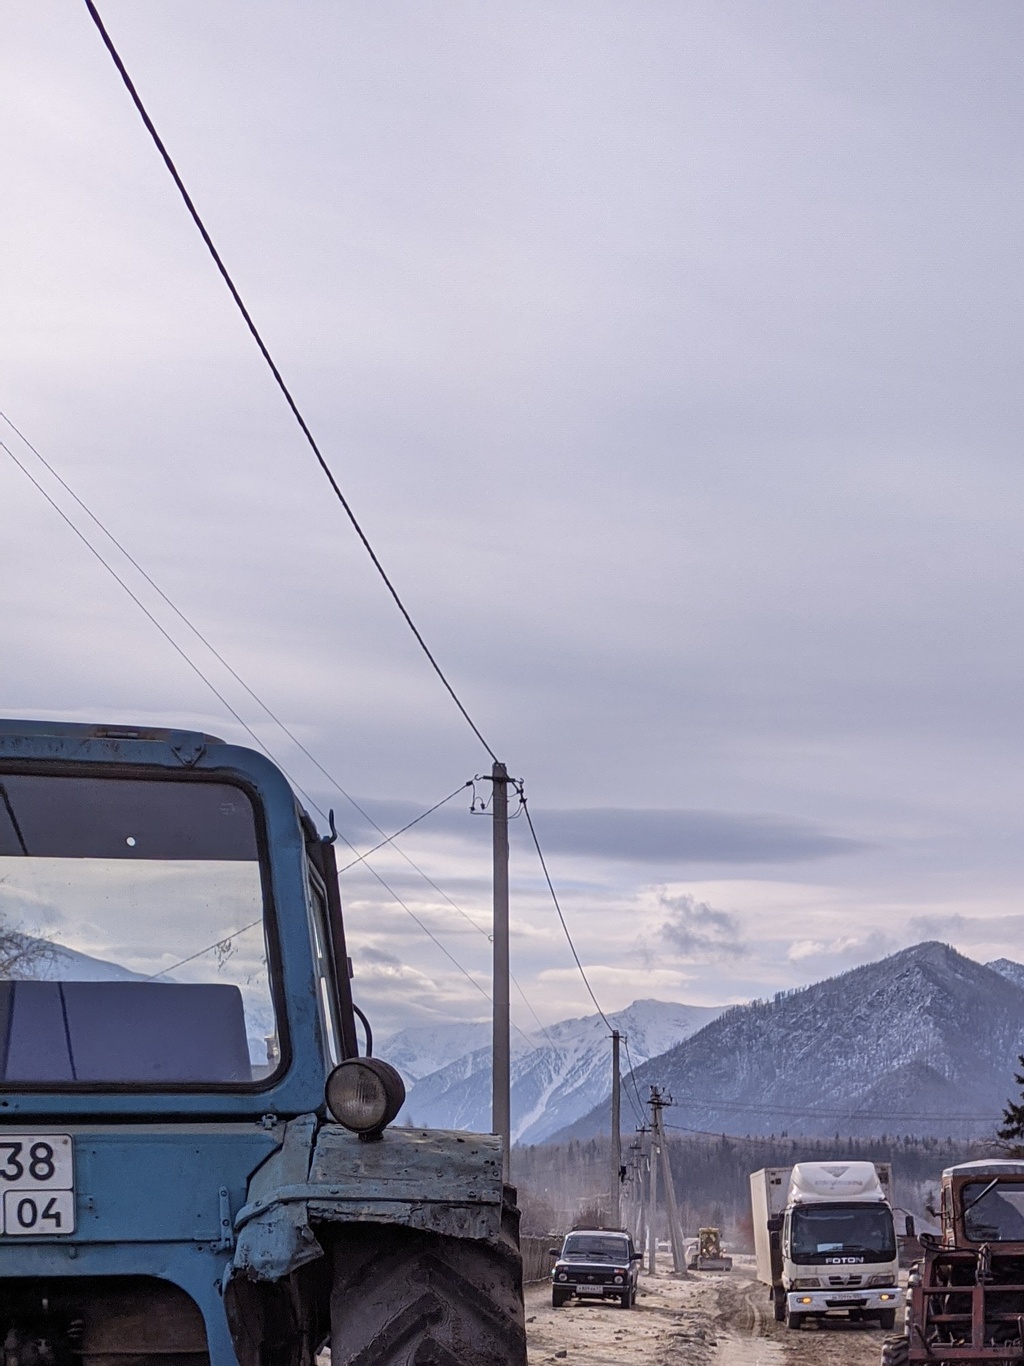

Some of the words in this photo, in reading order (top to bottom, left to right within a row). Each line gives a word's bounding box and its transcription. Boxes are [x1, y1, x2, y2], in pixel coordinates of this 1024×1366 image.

[0, 1142, 55, 1181] 38
[17, 1197, 61, 1228] 04
[825, 1256, 864, 1264] FOTON
